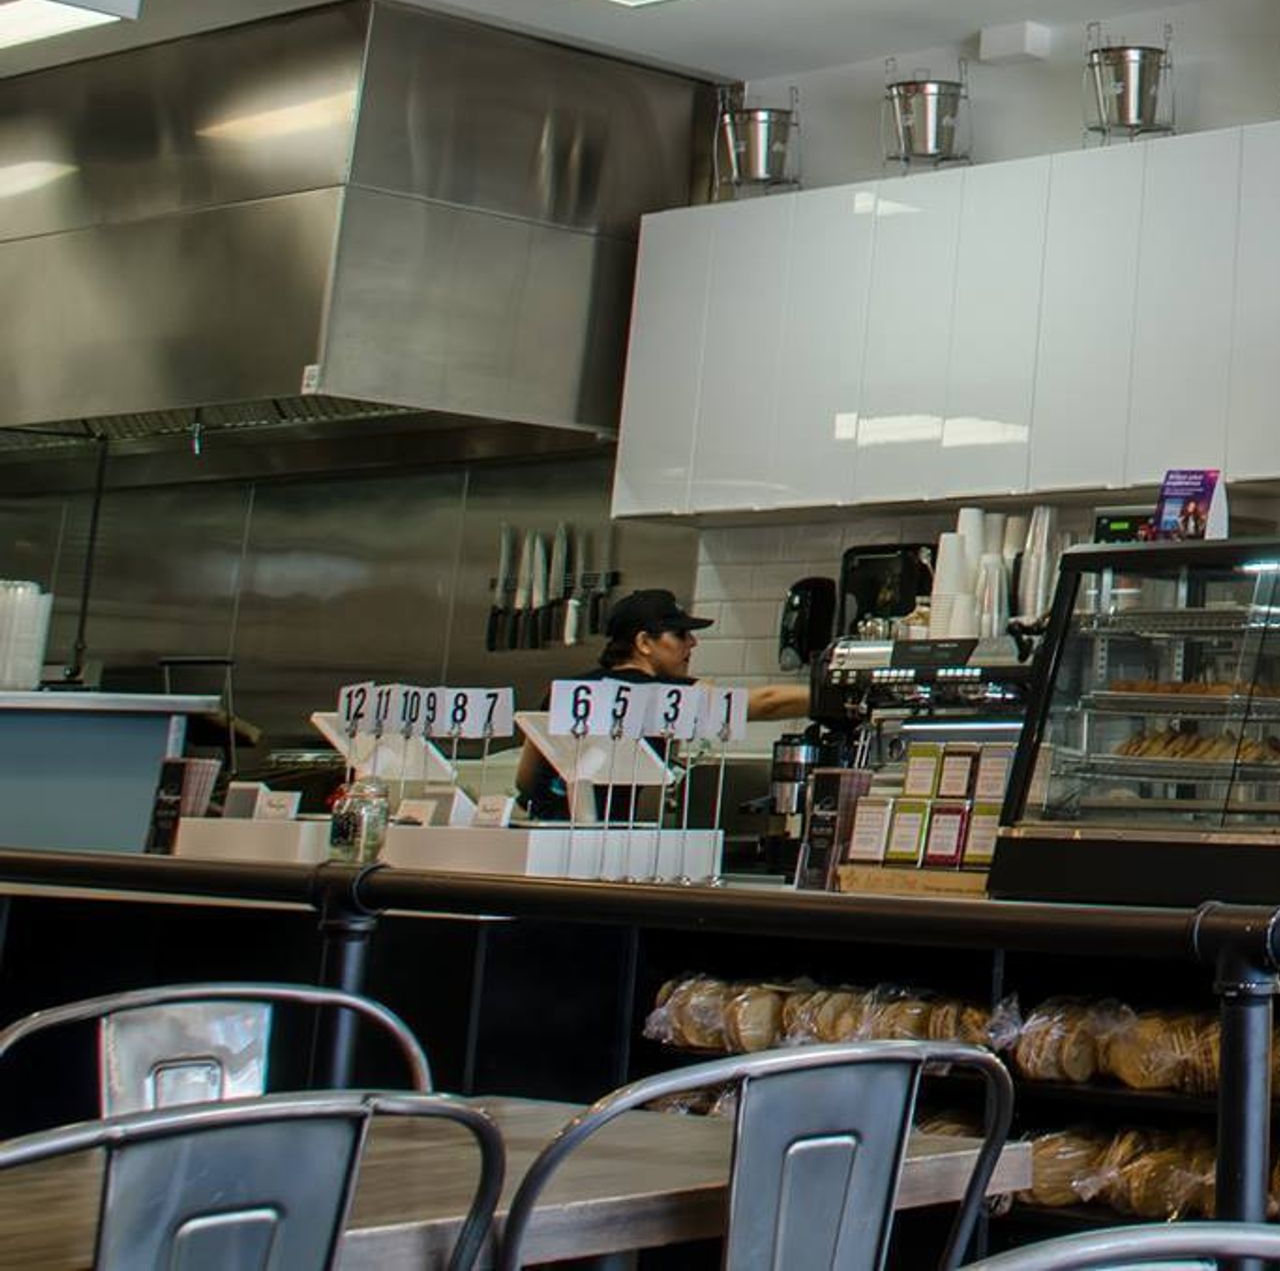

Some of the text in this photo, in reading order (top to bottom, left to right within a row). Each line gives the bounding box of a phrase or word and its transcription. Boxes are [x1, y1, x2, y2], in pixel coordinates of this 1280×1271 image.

[345, 687, 366, 721] 12
[375, 688, 391, 721] 11
[401, 689, 420, 723] 10
[425, 691, 437, 723] 9
[452, 693, 467, 723] 8
[483, 693, 499, 722] 7
[572, 685, 592, 720] 6
[612, 686, 631, 721] 5
[664, 689, 681, 722] 3
[724, 692, 733, 724] 1
